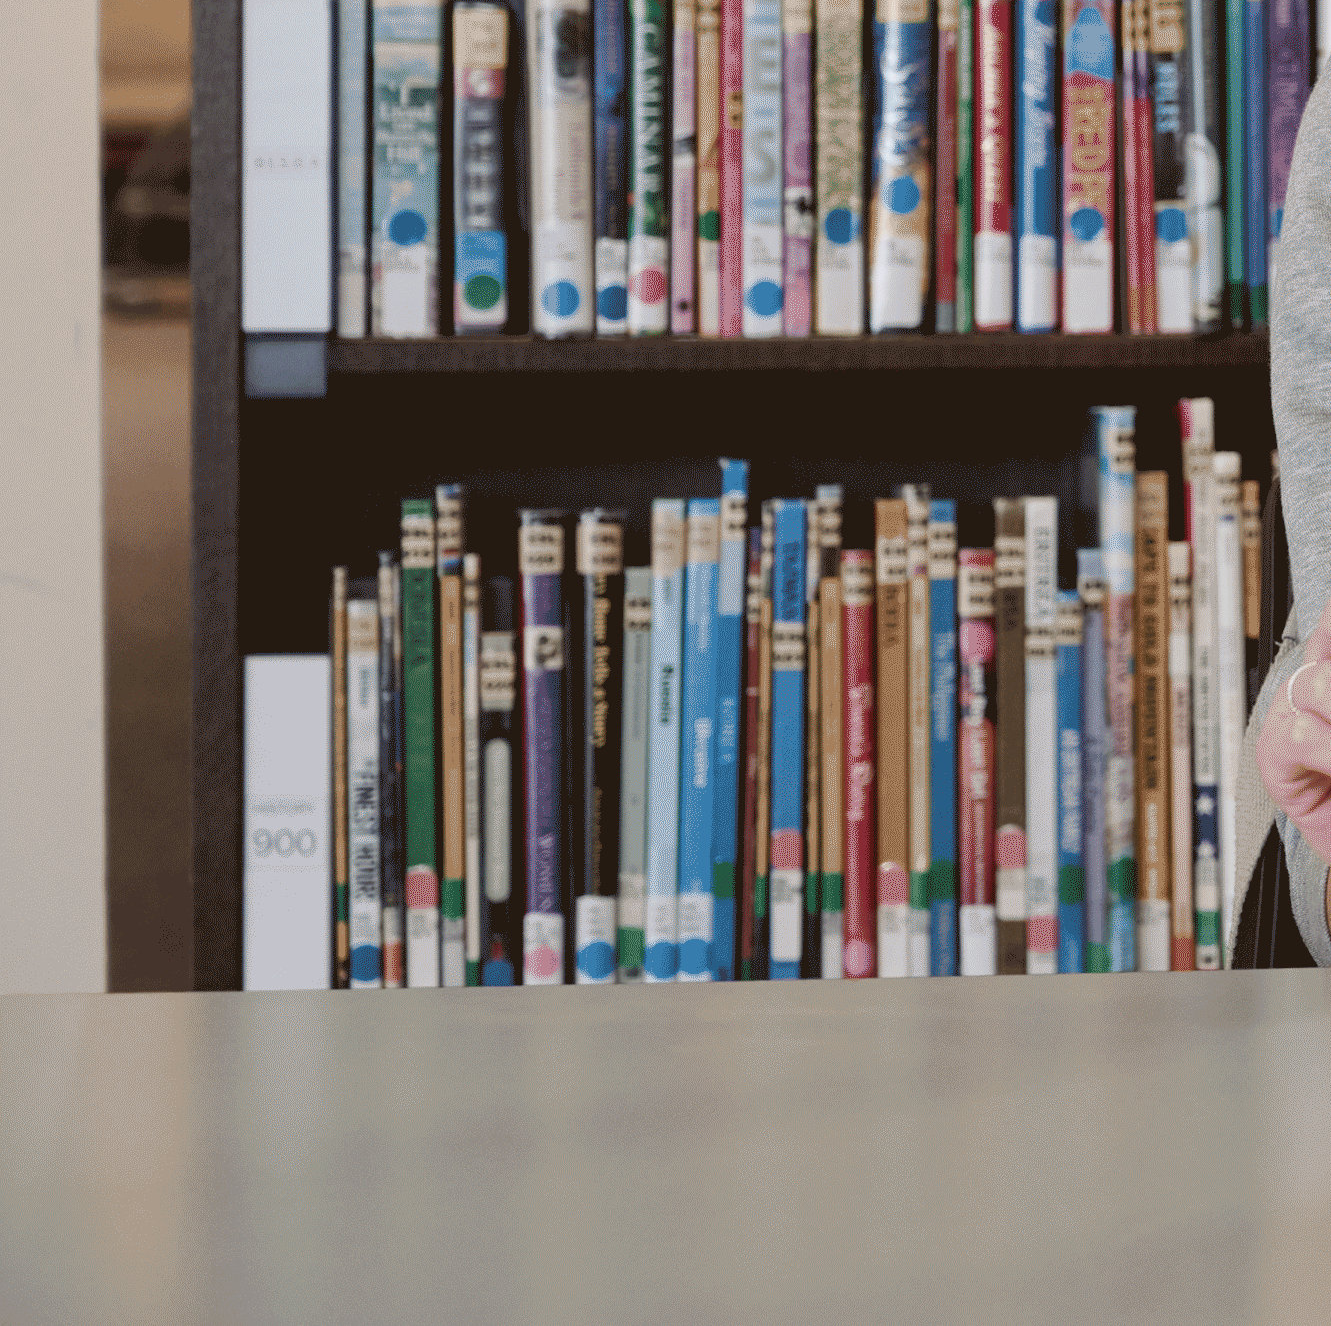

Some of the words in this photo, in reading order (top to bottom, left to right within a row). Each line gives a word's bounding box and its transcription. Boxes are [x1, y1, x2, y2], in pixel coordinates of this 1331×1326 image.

[636, 22, 663, 195] CAMINAR
[1071, 103, 1110, 171] RED
[1034, 526, 1052, 619] ERITREA
[934, 632, 954, 658] The
[659, 664, 676, 726] Russia
[692, 717, 712, 788] Ukraine
[252, 827, 318, 859] 900
